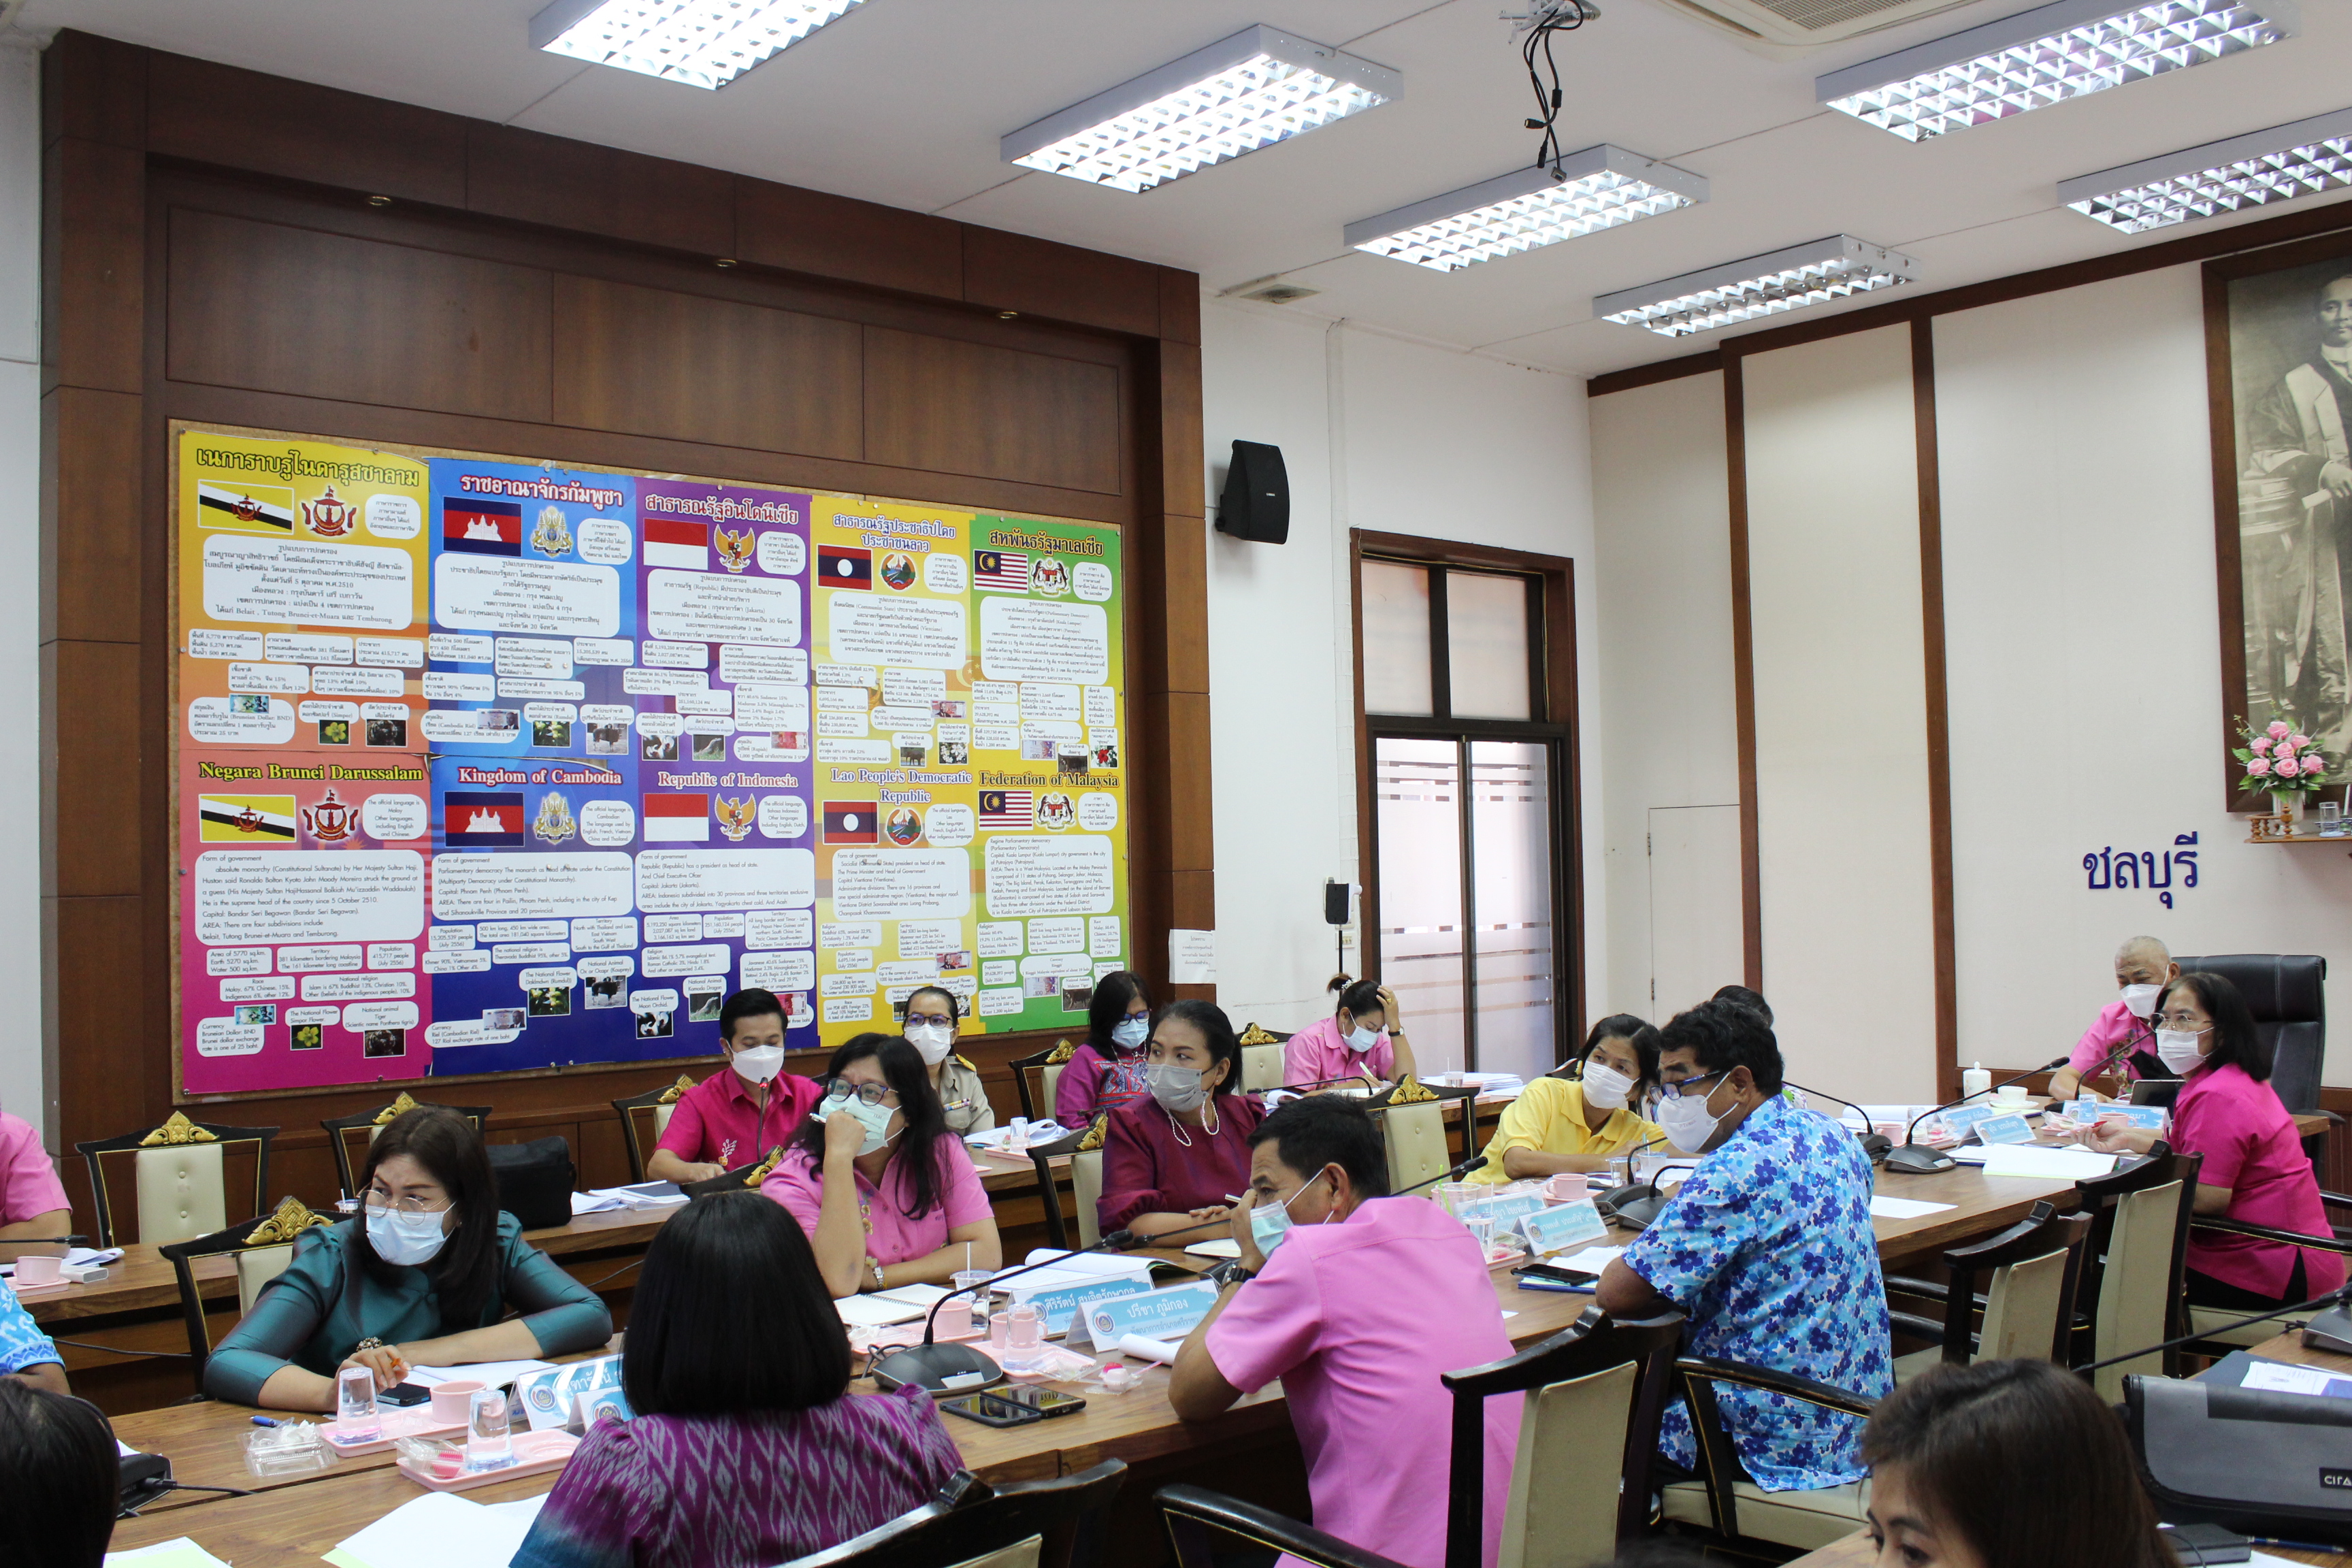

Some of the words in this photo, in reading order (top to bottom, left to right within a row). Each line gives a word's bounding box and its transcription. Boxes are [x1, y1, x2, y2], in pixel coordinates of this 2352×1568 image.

[197, 447, 419, 486] เนการาบรูไนดารุสซาลาม
[460, 475, 623, 510] ราชอาณาจักรกัมพูชา
[646, 495, 799, 524] สาธารณรัฐอินโดนีเซีย
[833, 513, 956, 538] สาธารณรัฐประชาธิปไตย
[861, 532, 930, 552] ประชาชนลาว
[989, 527, 1104, 556] สหพันธรัฐมาเลเซีย
[199, 762, 262, 781] Negara
[267, 763, 324, 780] Brunei
[330, 765, 423, 780] Darussalam
[459, 767, 527, 786] Kingdom
[532, 768, 547, 783] of
[552, 769, 622, 784] Cambodia
[658, 771, 717, 789] Republic
[720, 772, 735, 787] of
[738, 772, 798, 788] Indonesia
[831, 768, 855, 782] Lao
[858, 768, 905, 785] People's
[908, 770, 972, 784] Democratic
[979, 770, 1047, 787] Federation
[1050, 771, 1066, 787] of
[1066, 772, 1119, 790] Malaysia
[879, 788, 931, 805] Republic
[242, 865, 270, 873] monarchy
[2083, 831, 2199, 909] ชลบุรี
[1127, 1303, 1154, 1318] ปรีชา
[1157, 1297, 1189, 1317] ภูมิกอง
